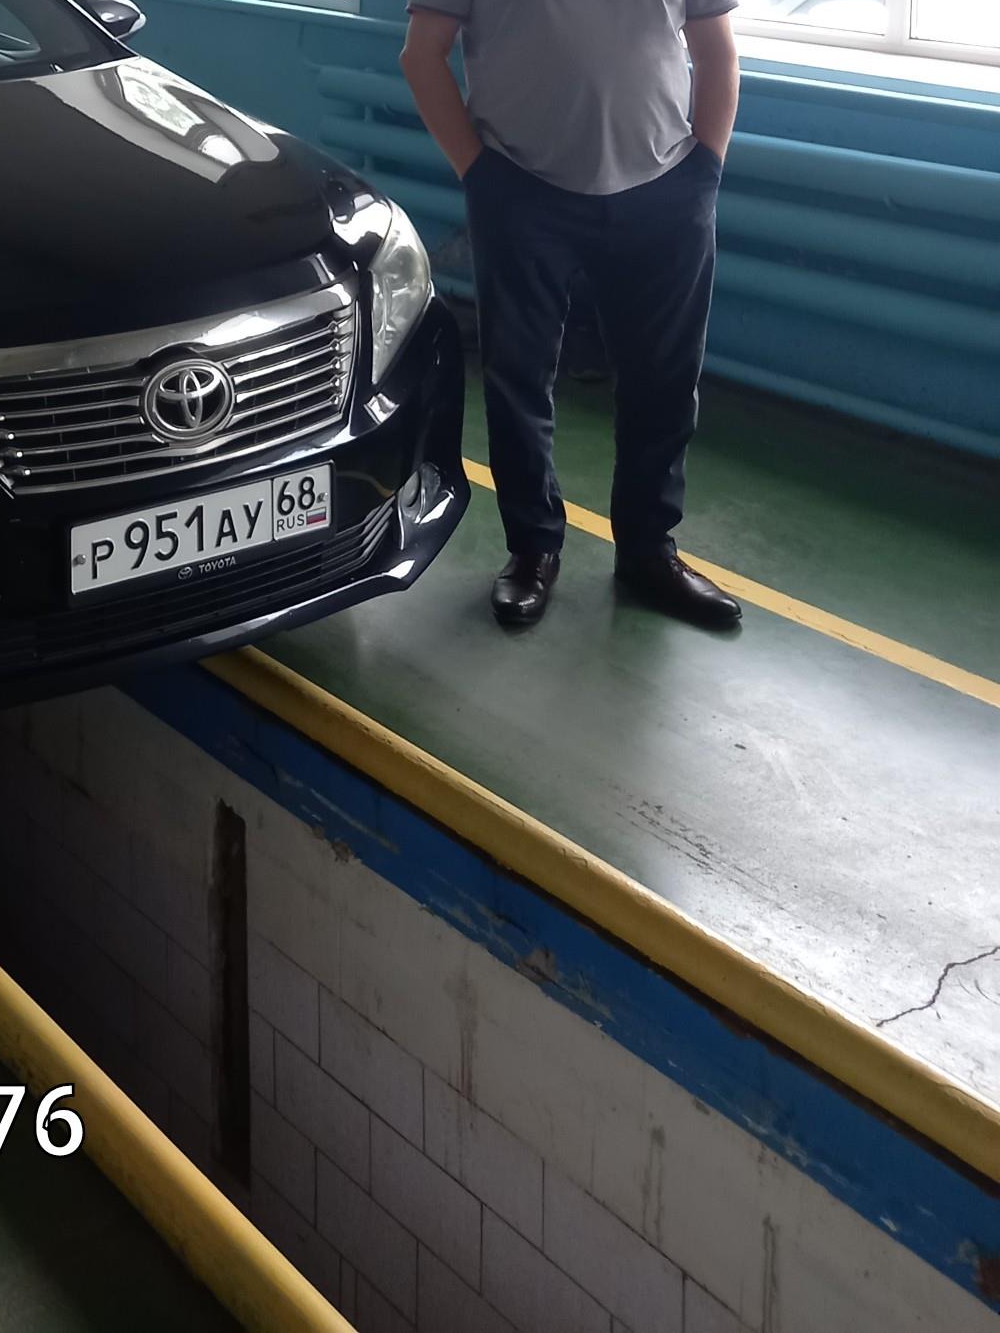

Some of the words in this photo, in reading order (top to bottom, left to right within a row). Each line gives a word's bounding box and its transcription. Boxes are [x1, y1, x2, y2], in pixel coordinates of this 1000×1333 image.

[276, 476, 316, 517] 68
[276, 515, 305, 532] RUS
[198, 555, 237, 574] TOYOTA
